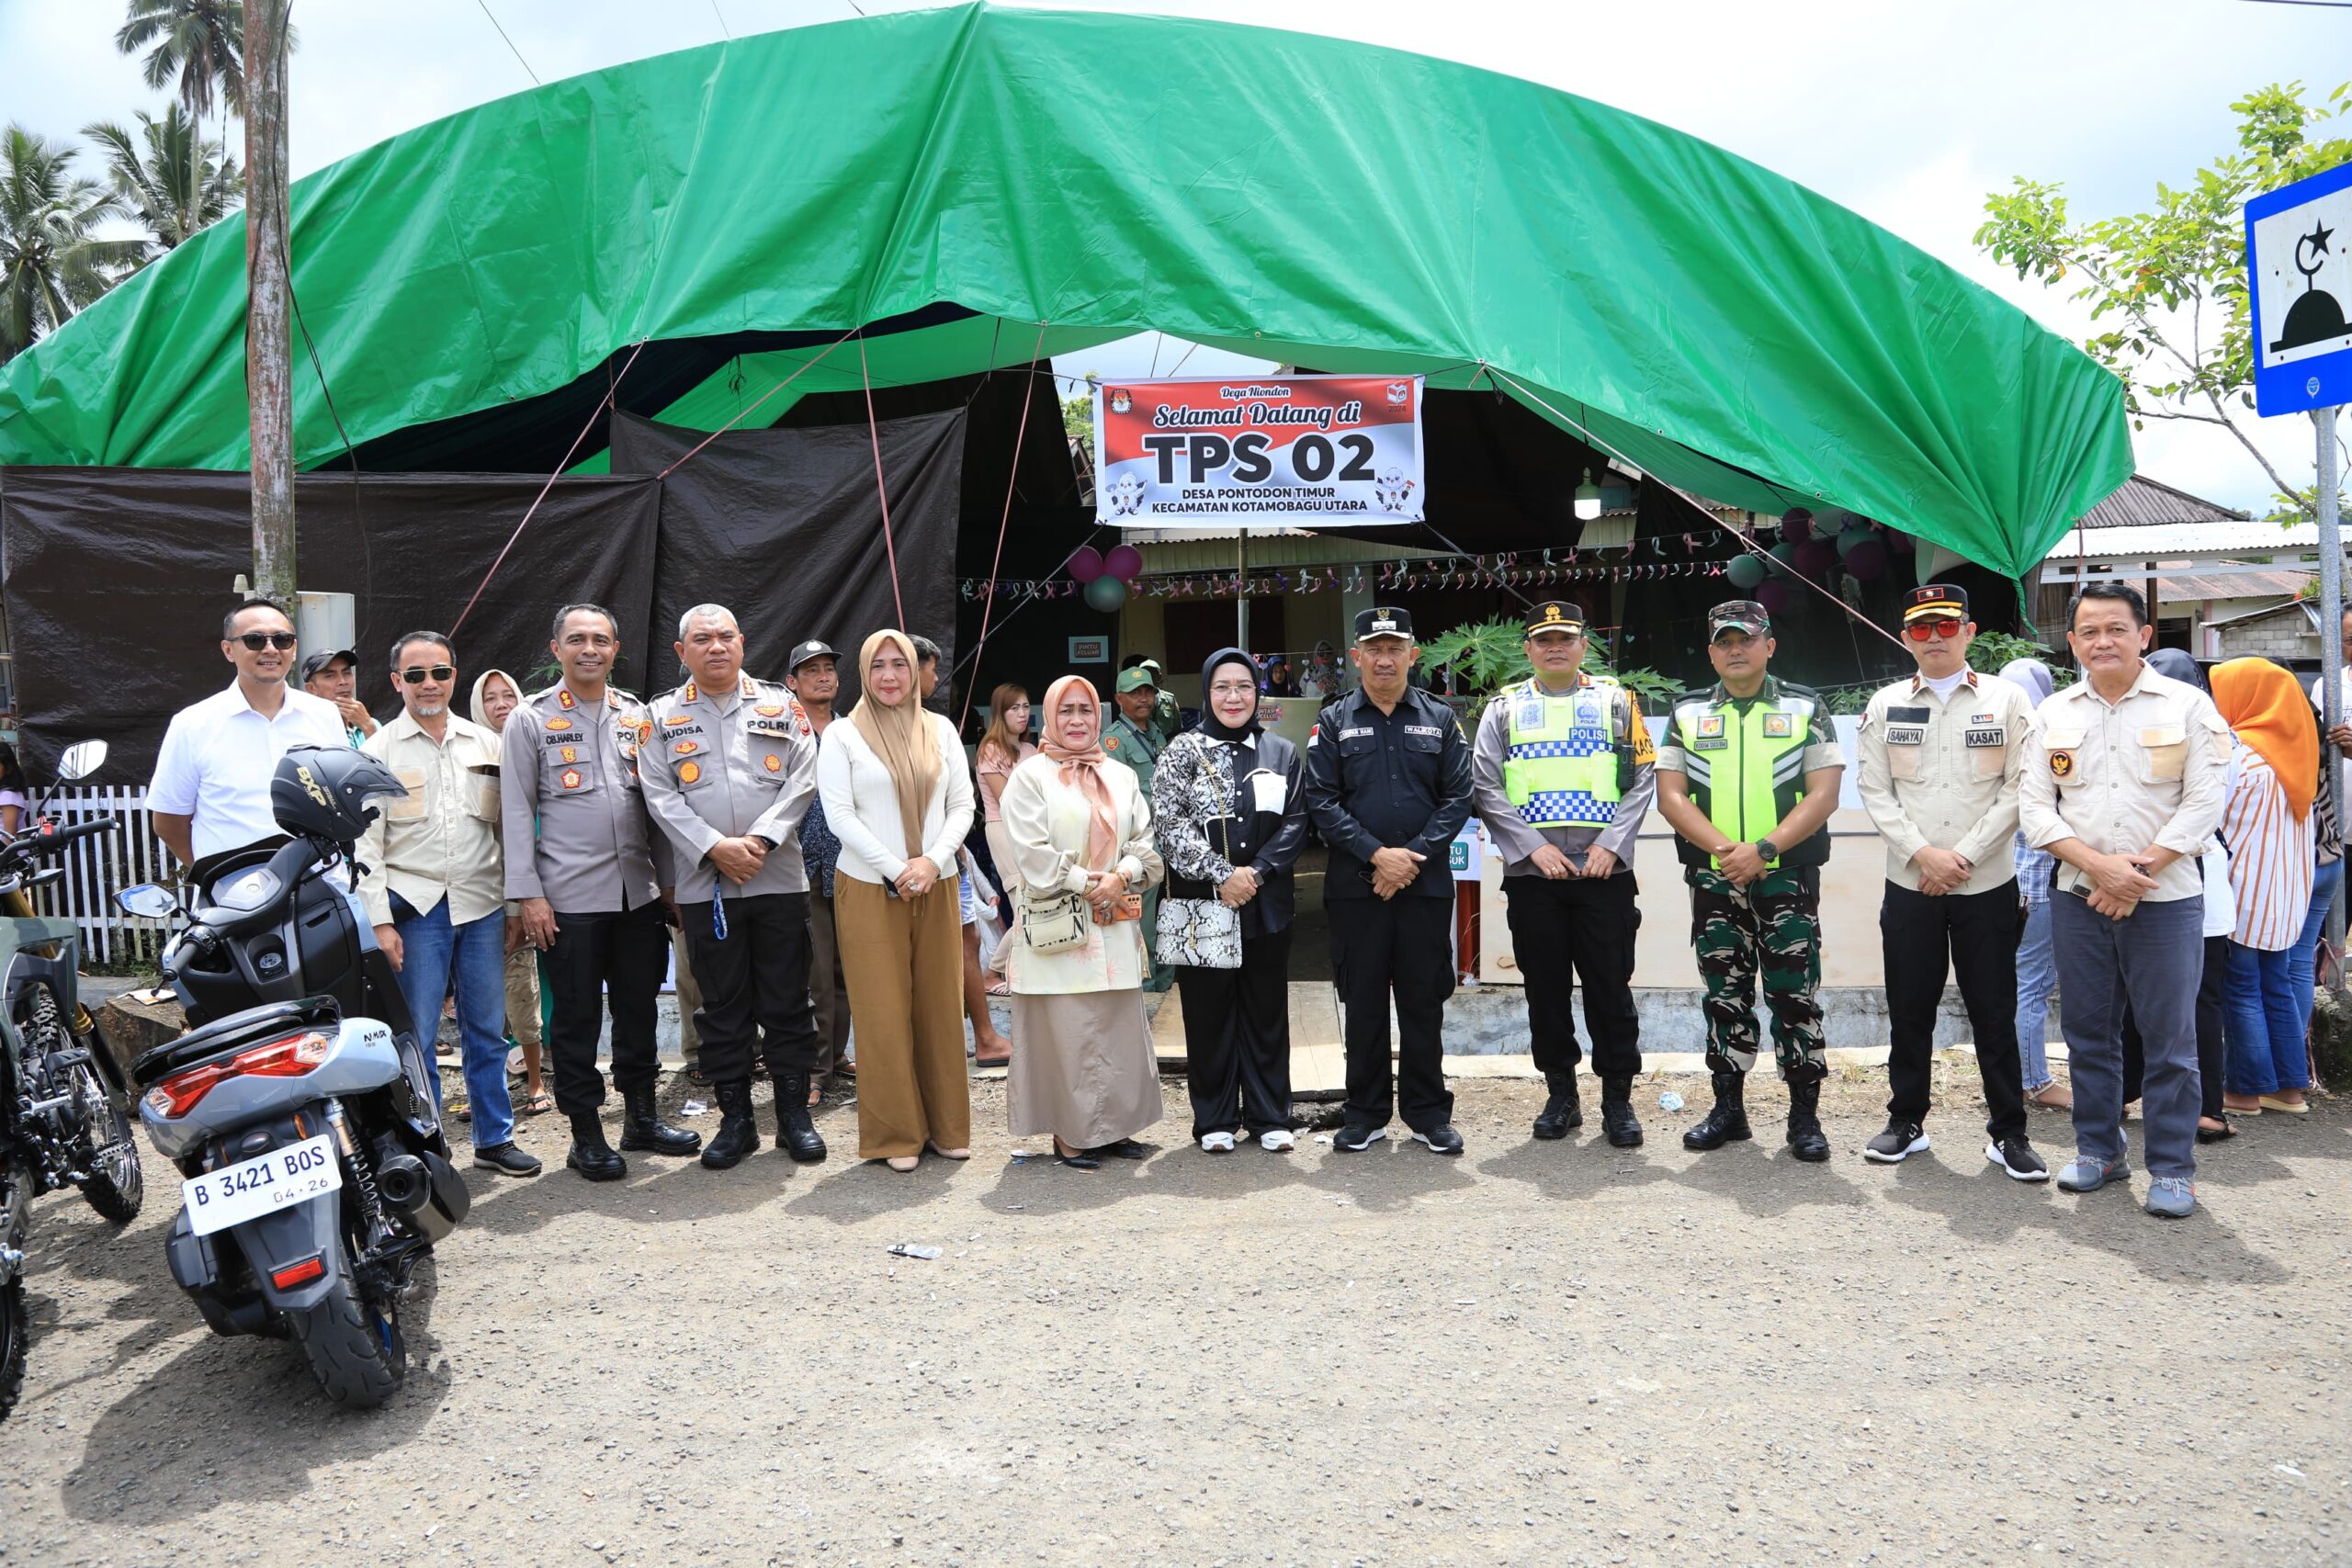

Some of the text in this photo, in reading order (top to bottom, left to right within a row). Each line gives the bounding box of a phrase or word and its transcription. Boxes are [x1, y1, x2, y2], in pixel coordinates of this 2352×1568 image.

[1221, 386, 1290, 400] Dega Niondon
[1154, 402, 1361, 429] Selamat Datang di
[1144, 434, 1375, 484] TPS 02
[1182, 487, 1336, 500] DESA PONTODON TIMUR
[1152, 500, 1368, 513] KECAMATAN KOTAMOBAGU UTARA
[747, 720, 789, 731] POLRI
[662, 725, 704, 742] BUDISA
[1571, 728, 1607, 740] POLISI
[1890, 730, 1919, 742] SAHAYA
[1968, 731, 2001, 745] KASAT
[194, 1145, 325, 1206] B 3421 BOS
